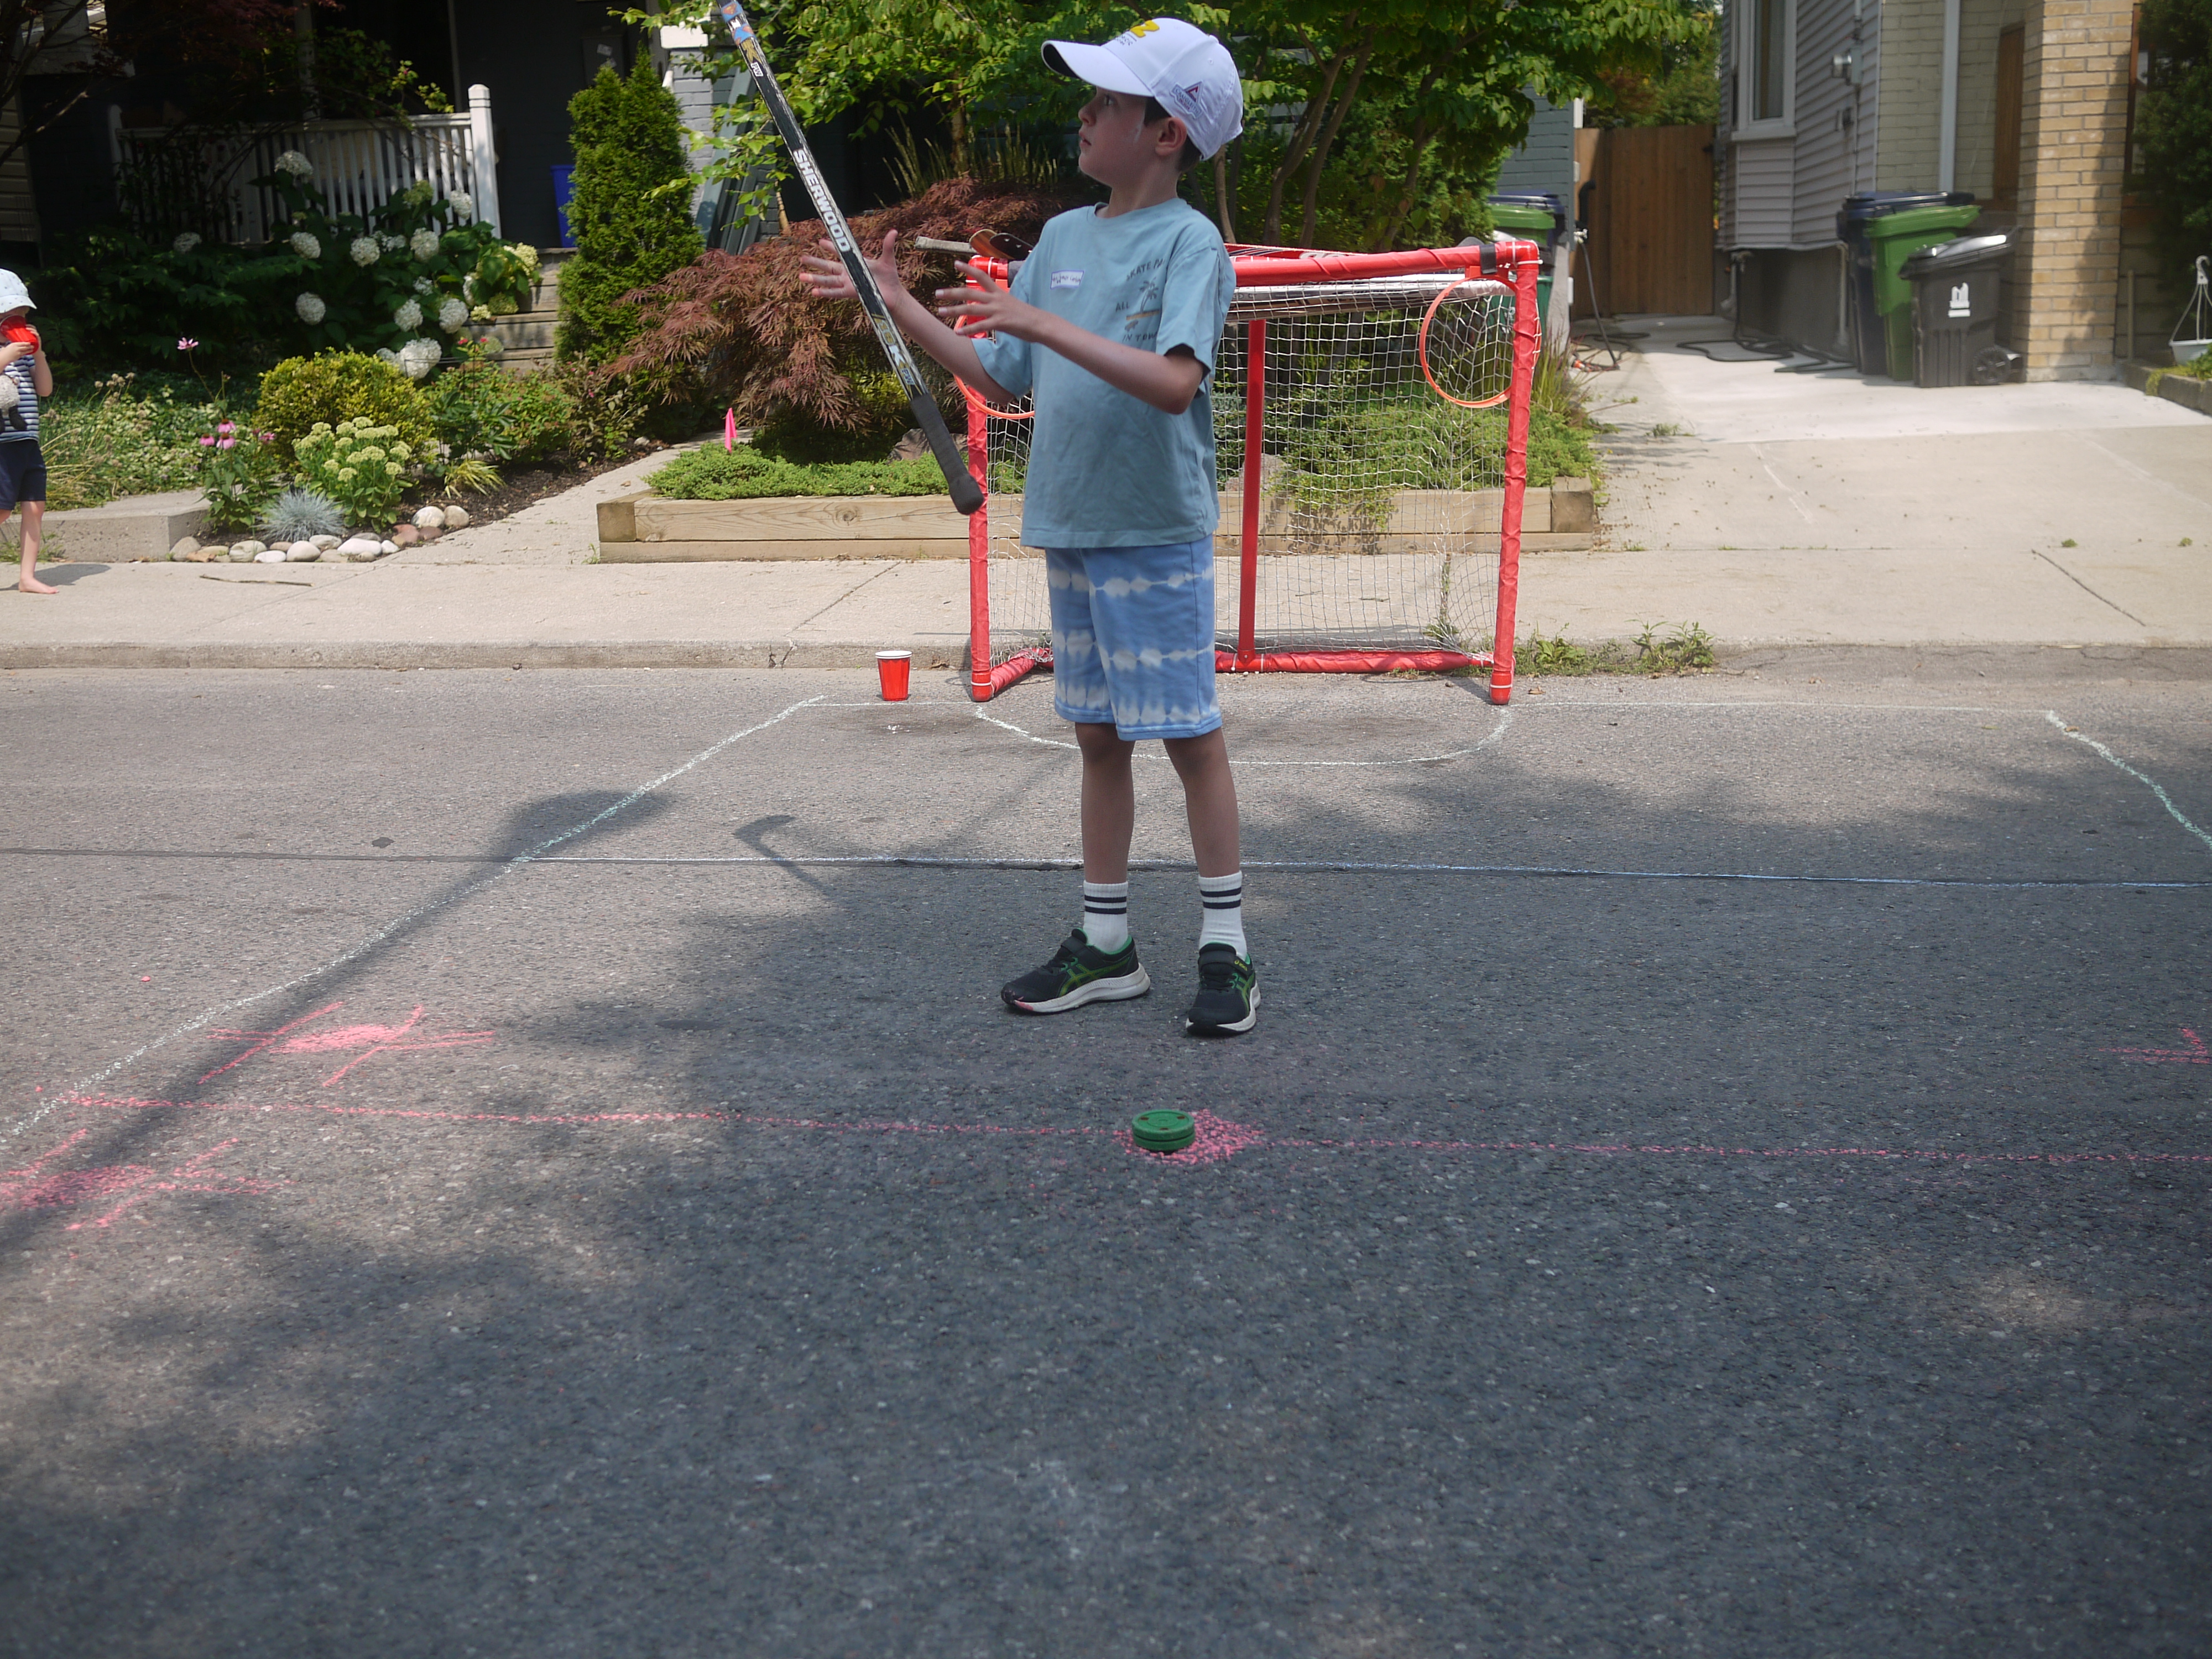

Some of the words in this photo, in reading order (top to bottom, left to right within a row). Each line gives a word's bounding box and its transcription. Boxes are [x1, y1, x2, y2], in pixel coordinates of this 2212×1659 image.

[751, 62, 763, 76] PW
[793, 149, 851, 252] SHERWOOD
[1115, 301, 1130, 312] ALL
